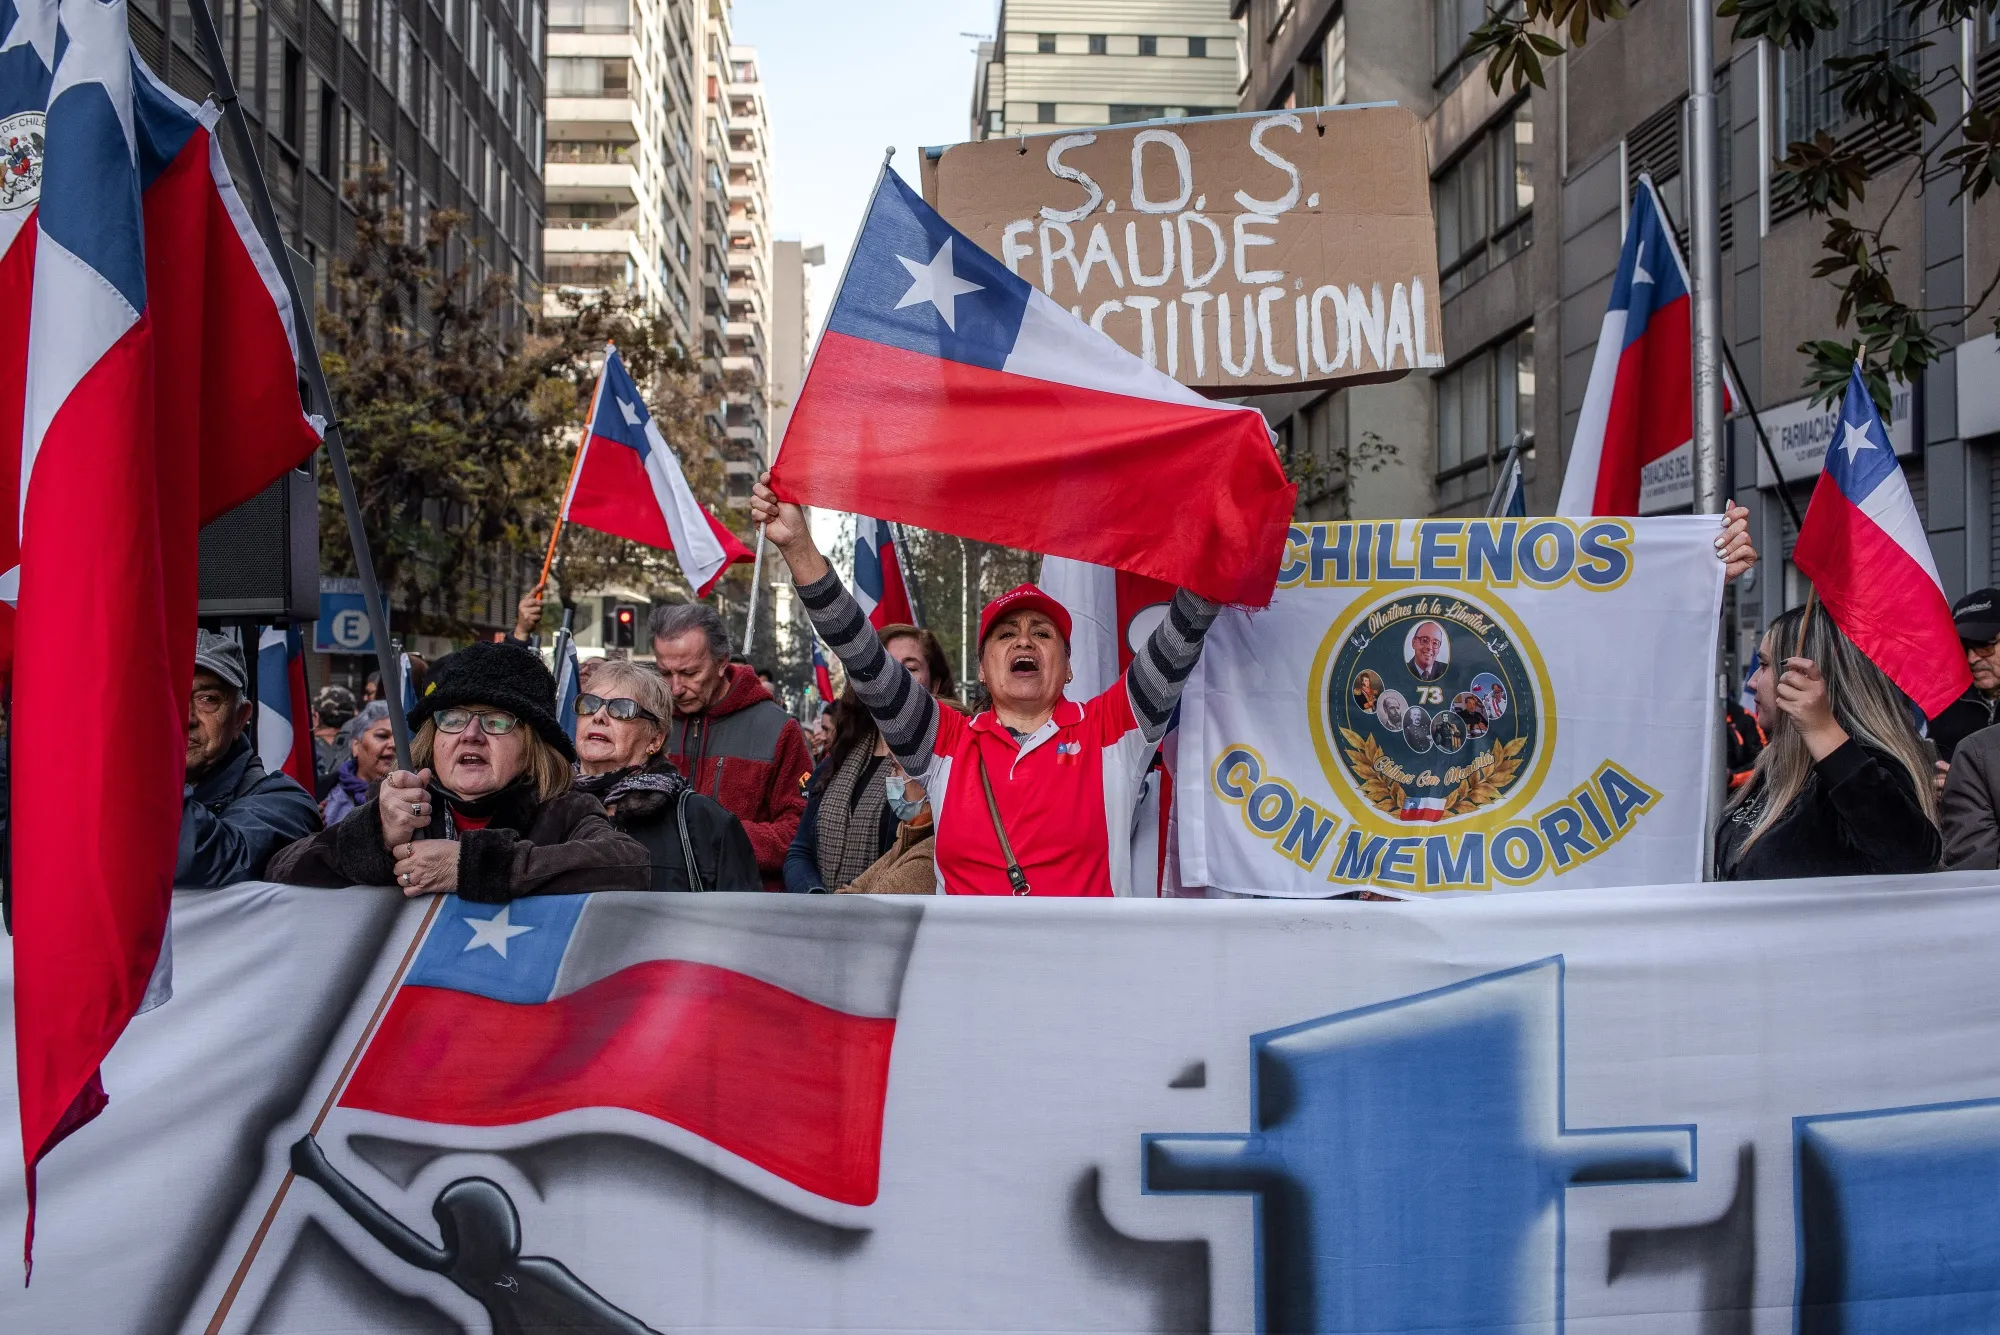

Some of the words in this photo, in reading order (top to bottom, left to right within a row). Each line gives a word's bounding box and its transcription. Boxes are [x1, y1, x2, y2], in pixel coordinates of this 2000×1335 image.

[1, 122, 17, 133] DE
[18, 117, 46, 128] CHILE
[1040, 114, 1320, 223] S.O.S.
[1002, 211, 1284, 295] FRAUDE
[1782, 412, 1838, 452] FARMACIAS
[1276, 520, 1630, 587] CHILENOS
[344, 616, 359, 640] E
[1415, 597, 1428, 615] de
[1430, 598, 1441, 615] la
[1445, 600, 1495, 635] Libertad
[1416, 685, 1443, 705] 73
[1373, 755, 1416, 785] Chilenos
[1416, 770, 1440, 788] Con
[1443, 749, 1495, 786] Memoria
[1214, 747, 1337, 868] CON
[1334, 763, 1656, 887] MEMORIA
